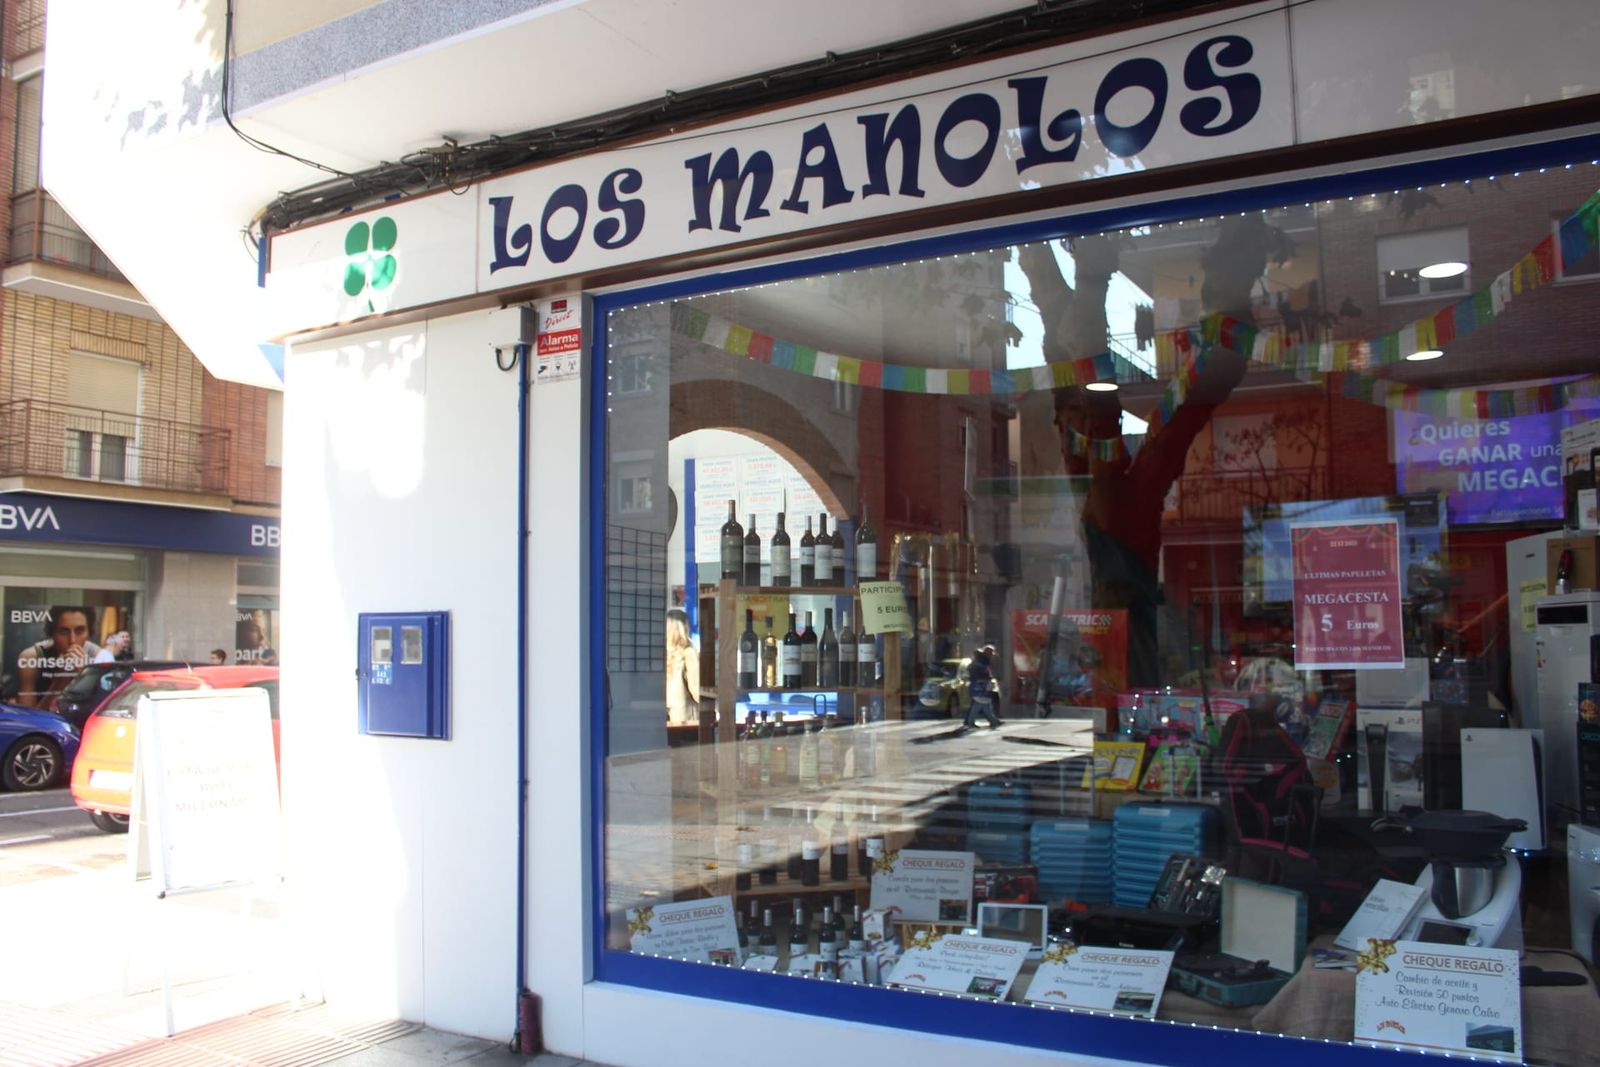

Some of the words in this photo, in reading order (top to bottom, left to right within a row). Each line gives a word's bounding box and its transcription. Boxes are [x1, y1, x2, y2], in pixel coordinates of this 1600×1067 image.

[489, 168, 645, 275] LOS
[685, 35, 1261, 234] MANOLOS
[541, 334, 578, 347] Alarma
[1439, 443, 1522, 466] GANAR
[1458, 465, 1562, 493] MEGAC
[1304, 591, 1389, 604] MEGACESTA
[11, 610, 52, 623] BBVA
[877, 606, 882, 614] 5
[1025, 614, 1100, 625] SCATRIC
[1321, 614, 1333, 632] 5
[1347, 620, 1379, 630] Euros
[902, 859, 932, 868] CHEQUE
[934, 860, 965, 869] REGALO
[659, 911, 690, 923] CHEQUE
[693, 906, 724, 918] REGALO
[944, 940, 979, 951] CHEQUE
[982, 945, 1017, 955] REGALO
[1081, 952, 1120, 962] CHEQUE
[1121, 956, 1160, 966] REGALO
[1403, 954, 1451, 968] CHEQUE
[1454, 959, 1504, 973] REGALO
[1395, 970, 1429, 985] Cambio
[1431, 976, 1442, 986] de
[1444, 977, 1469, 988] aceite
[1472, 982, 1478, 991] y
[1375, 996, 1399, 1008] Auto
[1402, 998, 1436, 1011] Electro
[1436, 989, 1449, 999] 50
[1452, 992, 1479, 1003] puntos
